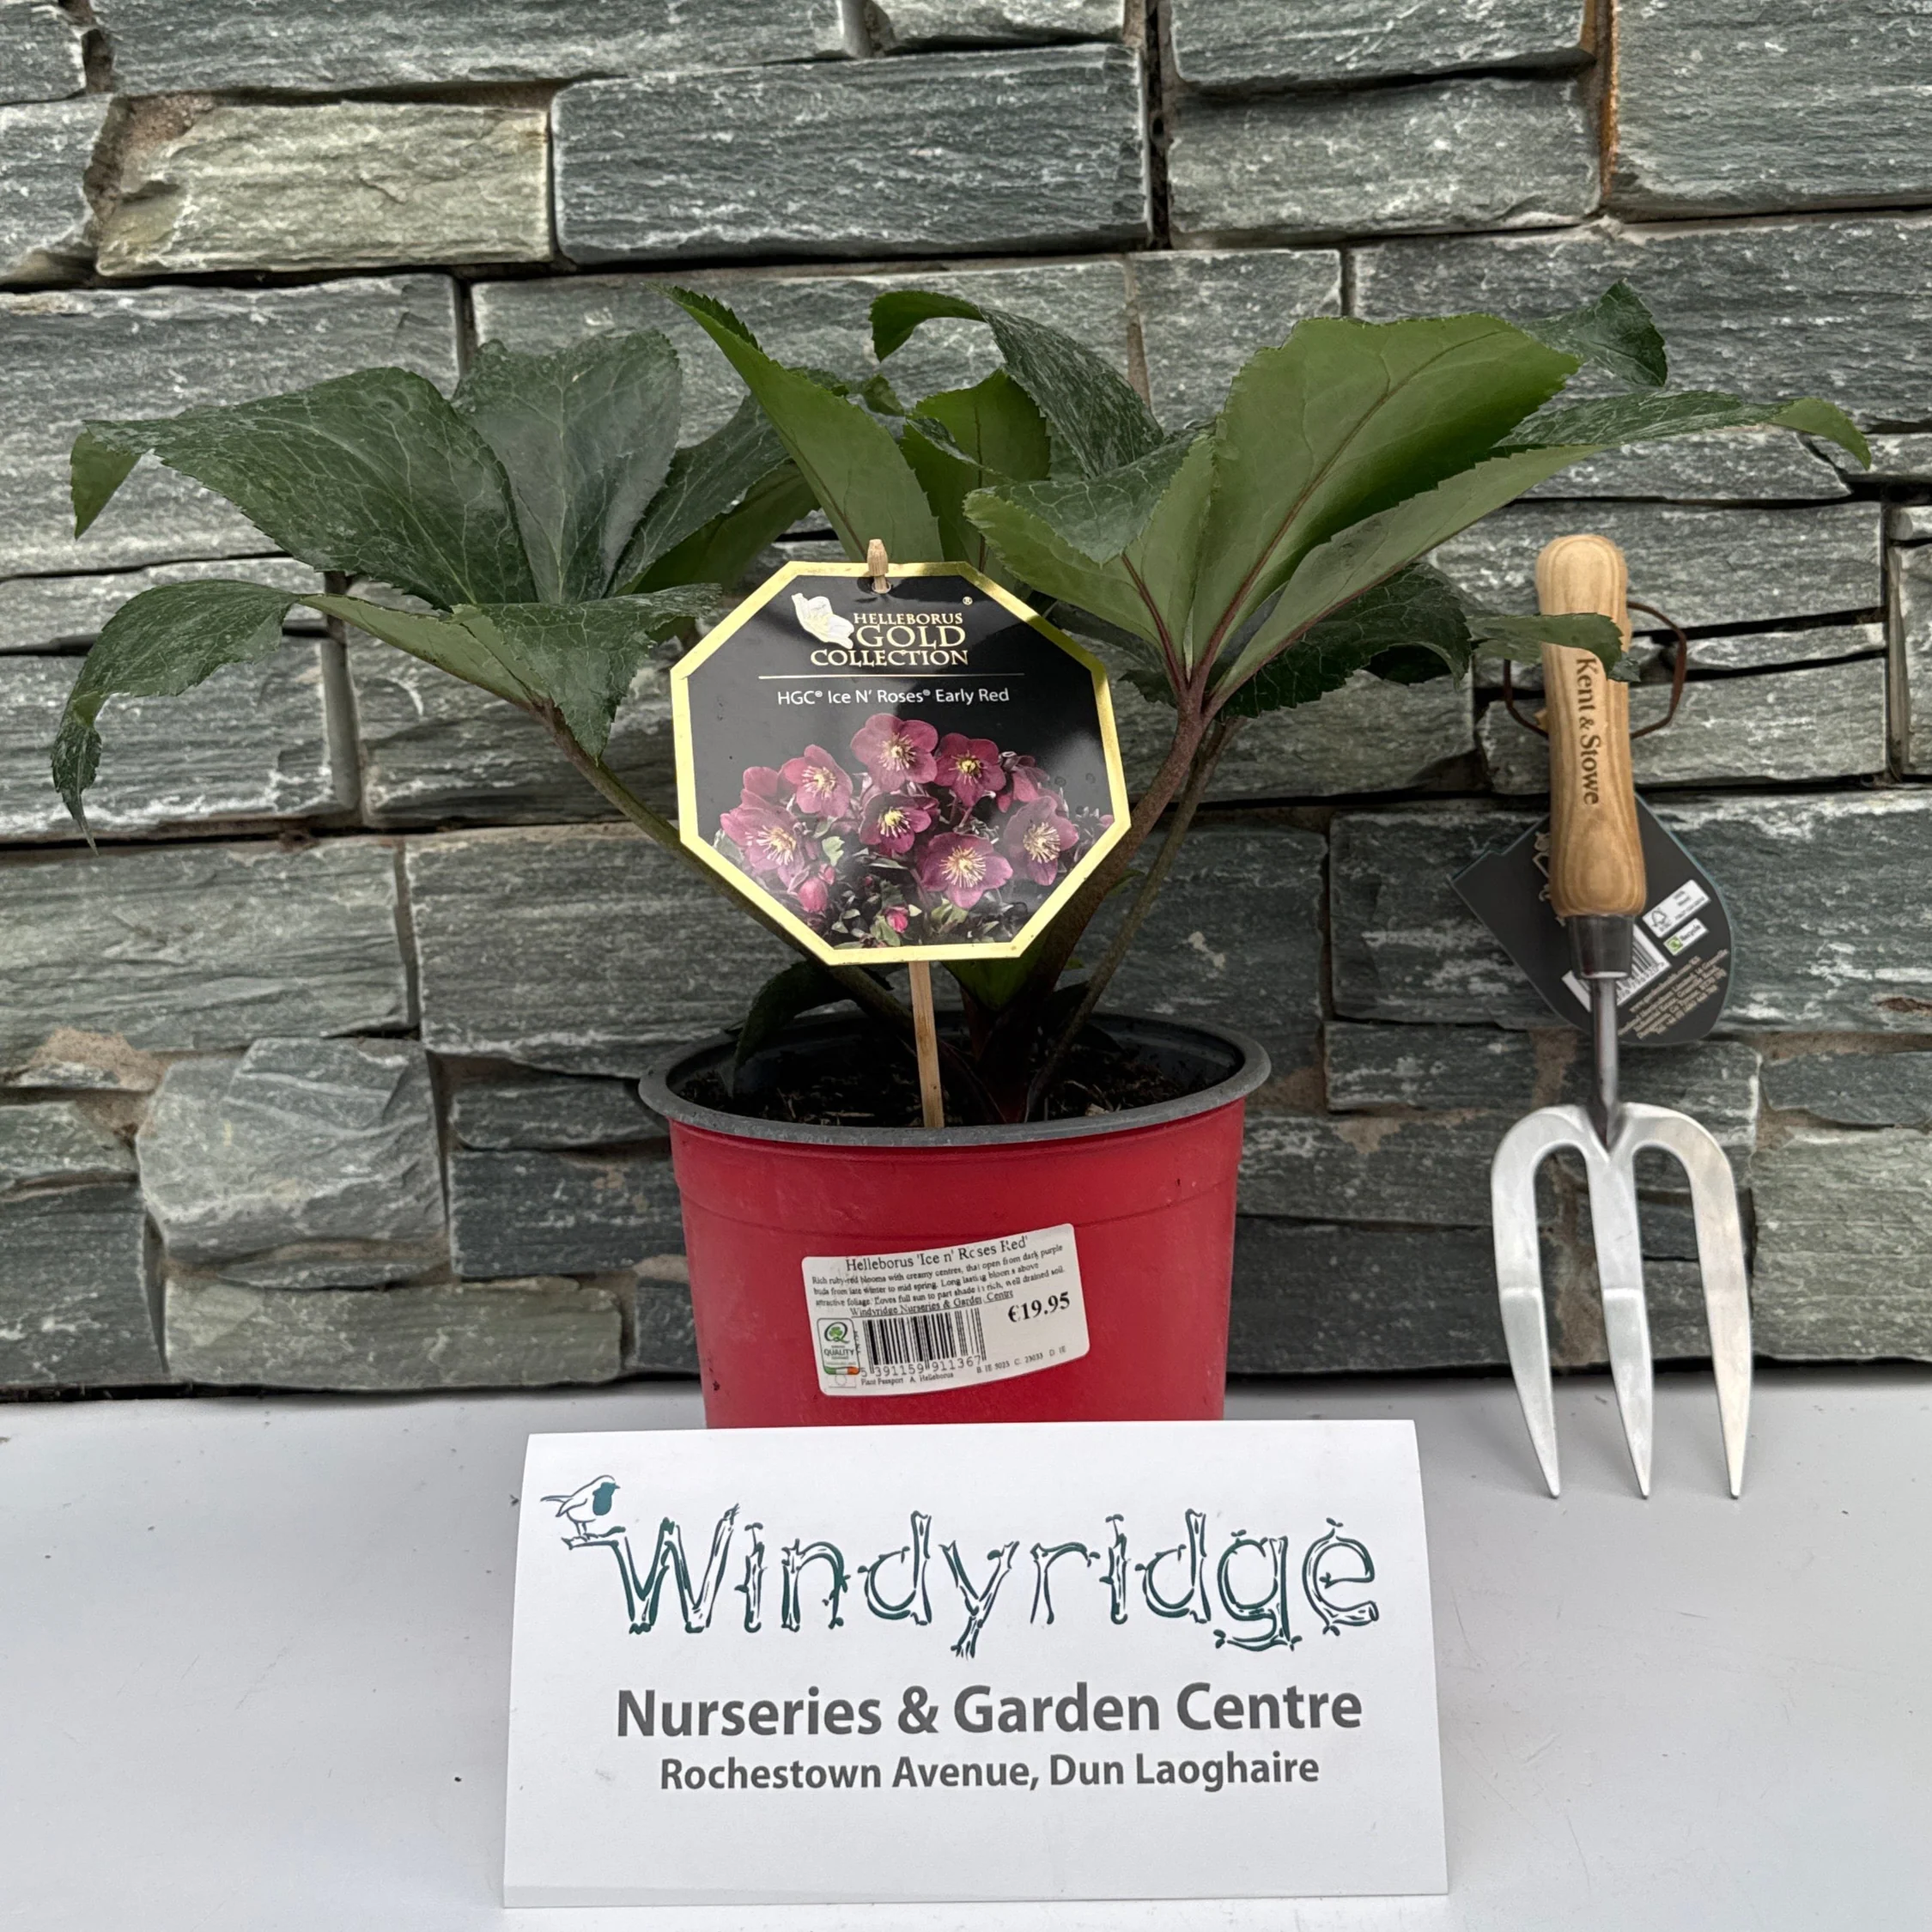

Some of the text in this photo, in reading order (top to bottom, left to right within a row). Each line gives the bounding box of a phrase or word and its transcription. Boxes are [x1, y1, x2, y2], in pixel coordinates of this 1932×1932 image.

[854, 612, 963, 625] HELLEBORUS
[856, 624, 966, 648] GOLD
[810, 649, 969, 667] COLLECTION
[828, 690, 851, 704] Ice
[935, 688, 975, 705] Early
[978, 687, 1010, 702] Red
[1575, 658, 1601, 805] Kent & Stowe
[812, 1276, 828, 1285] Rich
[860, 1274, 886, 1283] blooms
[889, 1272, 904, 1281] with
[906, 1270, 933, 1280] creamy
[966, 1264, 980, 1273] that
[982, 1261, 1000, 1271] open
[1003, 1256, 1021, 1266] from
[1023, 1251, 1039, 1261] dark
[1041, 1244, 1062, 1258] purple
[846, 1257, 914, 1271] Helleborus
[958, 1245, 996, 1260] Roses
[831, 1287, 848, 1296] from
[863, 1285, 885, 1295] winter
[897, 1283, 911, 1291] mid
[940, 1278, 961, 1288] Long
[1018, 1262, 1039, 1273] above
[898, 1294, 910, 1303] full
[938, 1291, 952, 1301] part
[954, 1287, 975, 1297] shade
[1023, 1270, 1049, 1284] drained
[849, 1304, 898, 1316] Windyridge
[900, 1301, 940, 1315] Nurseries
[943, 1299, 951, 1309] &
[1008, 1291, 1070, 1323] €19.95
[587, 1504, 1379, 1659] Windyridge
[617, 1681, 1362, 1737] Nurseries & Garden Centre
[660, 1751, 1320, 1792] Rochestown Avenue, Dun Laoghaire
